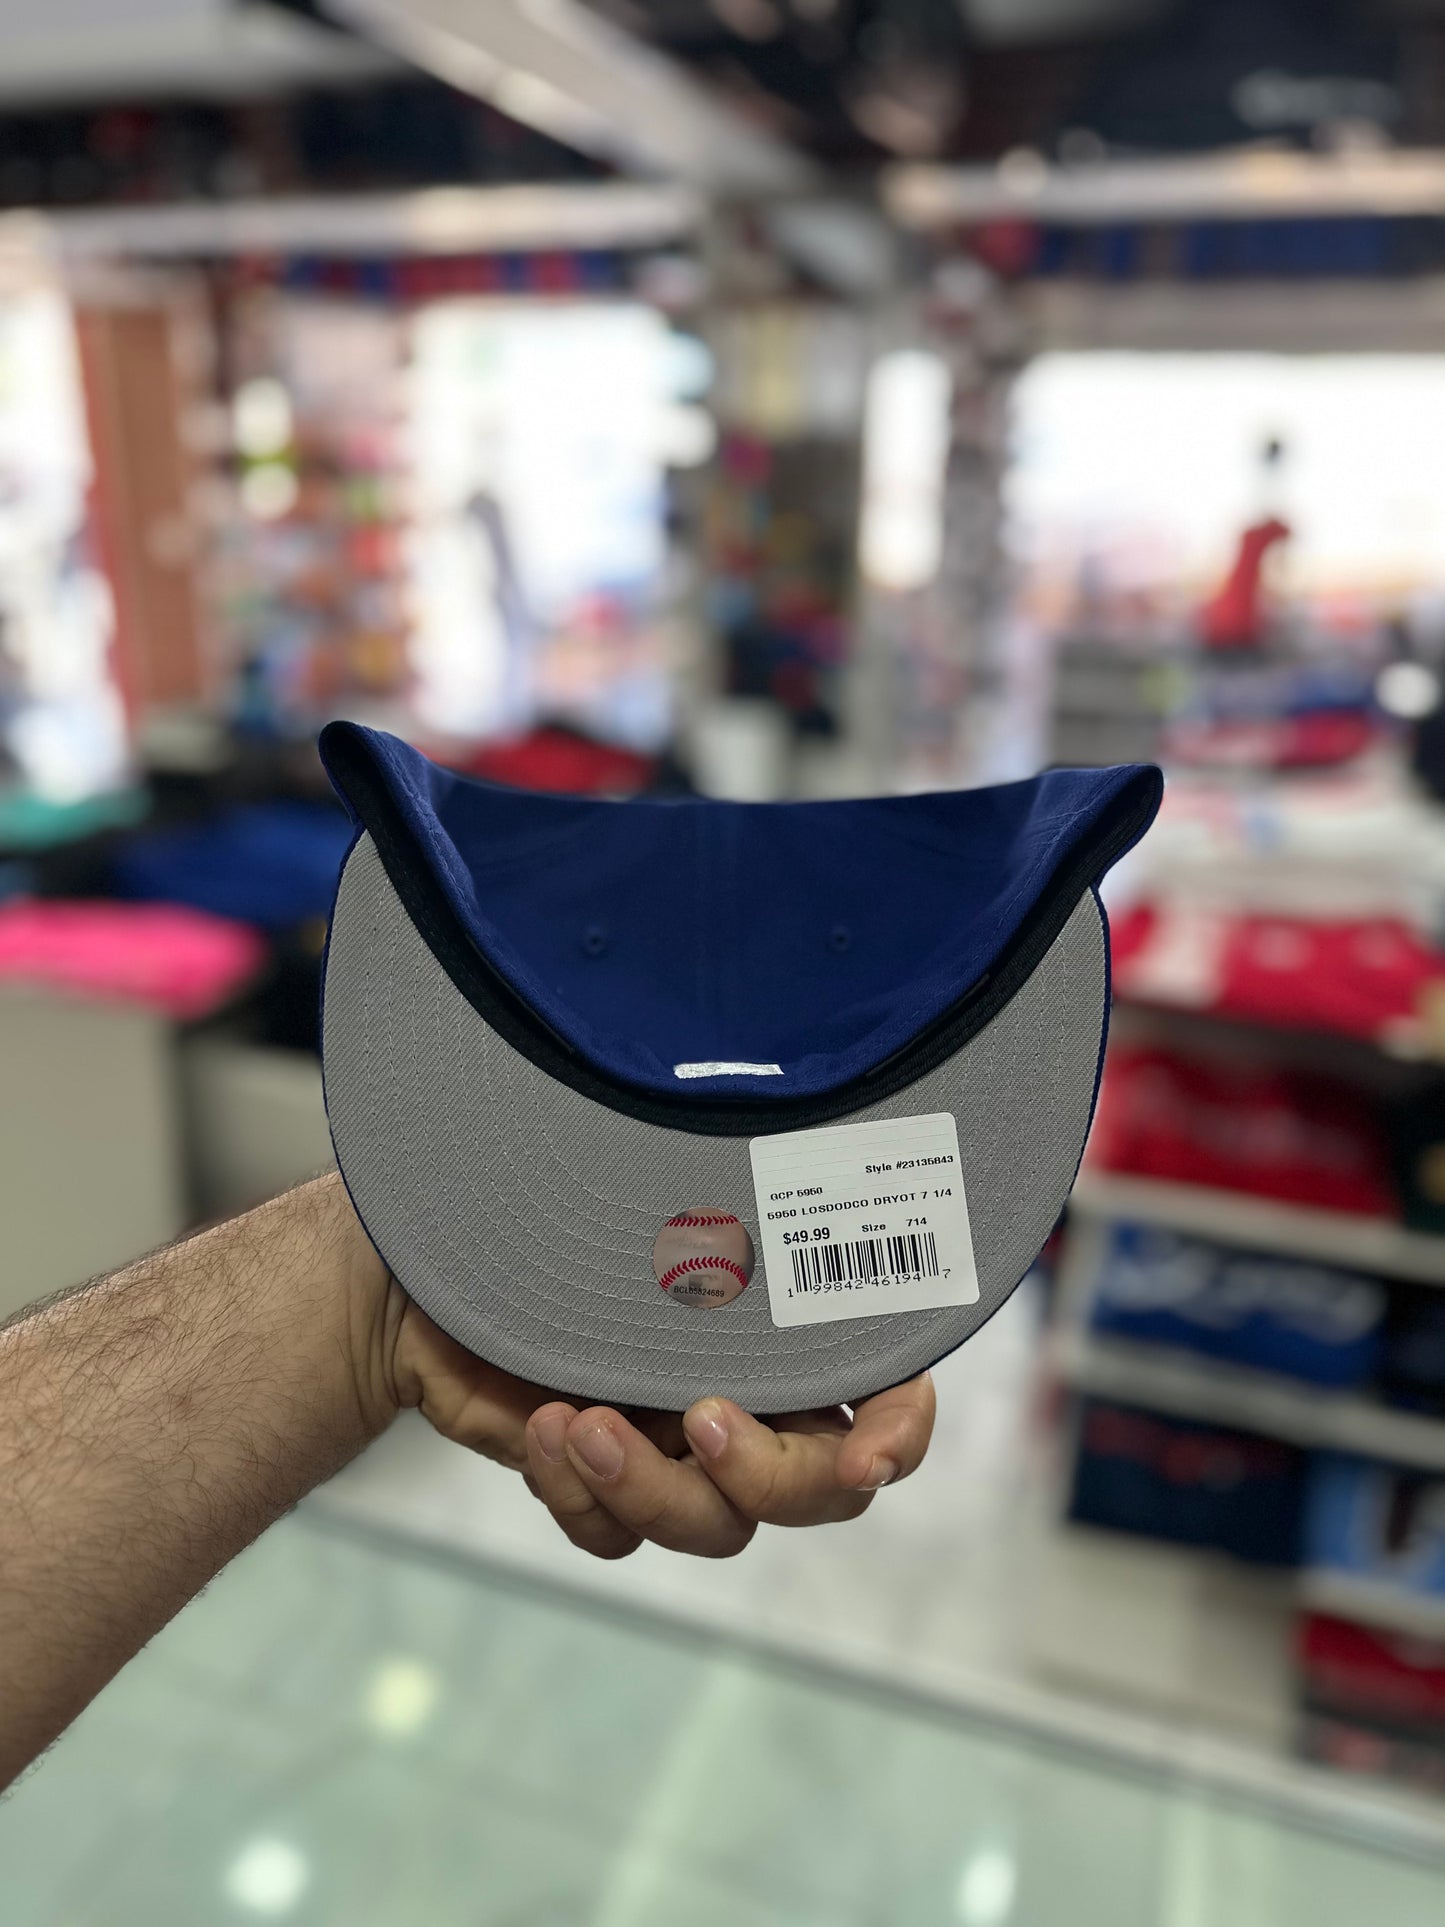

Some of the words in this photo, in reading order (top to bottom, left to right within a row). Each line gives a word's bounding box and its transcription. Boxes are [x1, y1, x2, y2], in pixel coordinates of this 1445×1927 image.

[865, 1163, 892, 1174] Style
[896, 1155, 954, 1169] #23135843
[767, 1209, 797, 1220] 5950
[802, 1199, 869, 1216] LOSDODCO
[873, 1192, 916, 1206] DRYOT
[920, 1191, 928, 1200] 7
[933, 1188, 952, 1198] 1/4
[797, 1187, 823, 1197] 5950
[783, 1227, 830, 1245] $49.99
[861, 1222, 886, 1233] Size
[905, 1217, 927, 1227] 714
[787, 1288, 794, 1298] 1
[813, 1280, 864, 1294] 99842
[871, 1273, 921, 1287] 46194
[942, 1268, 951, 1279] 7
